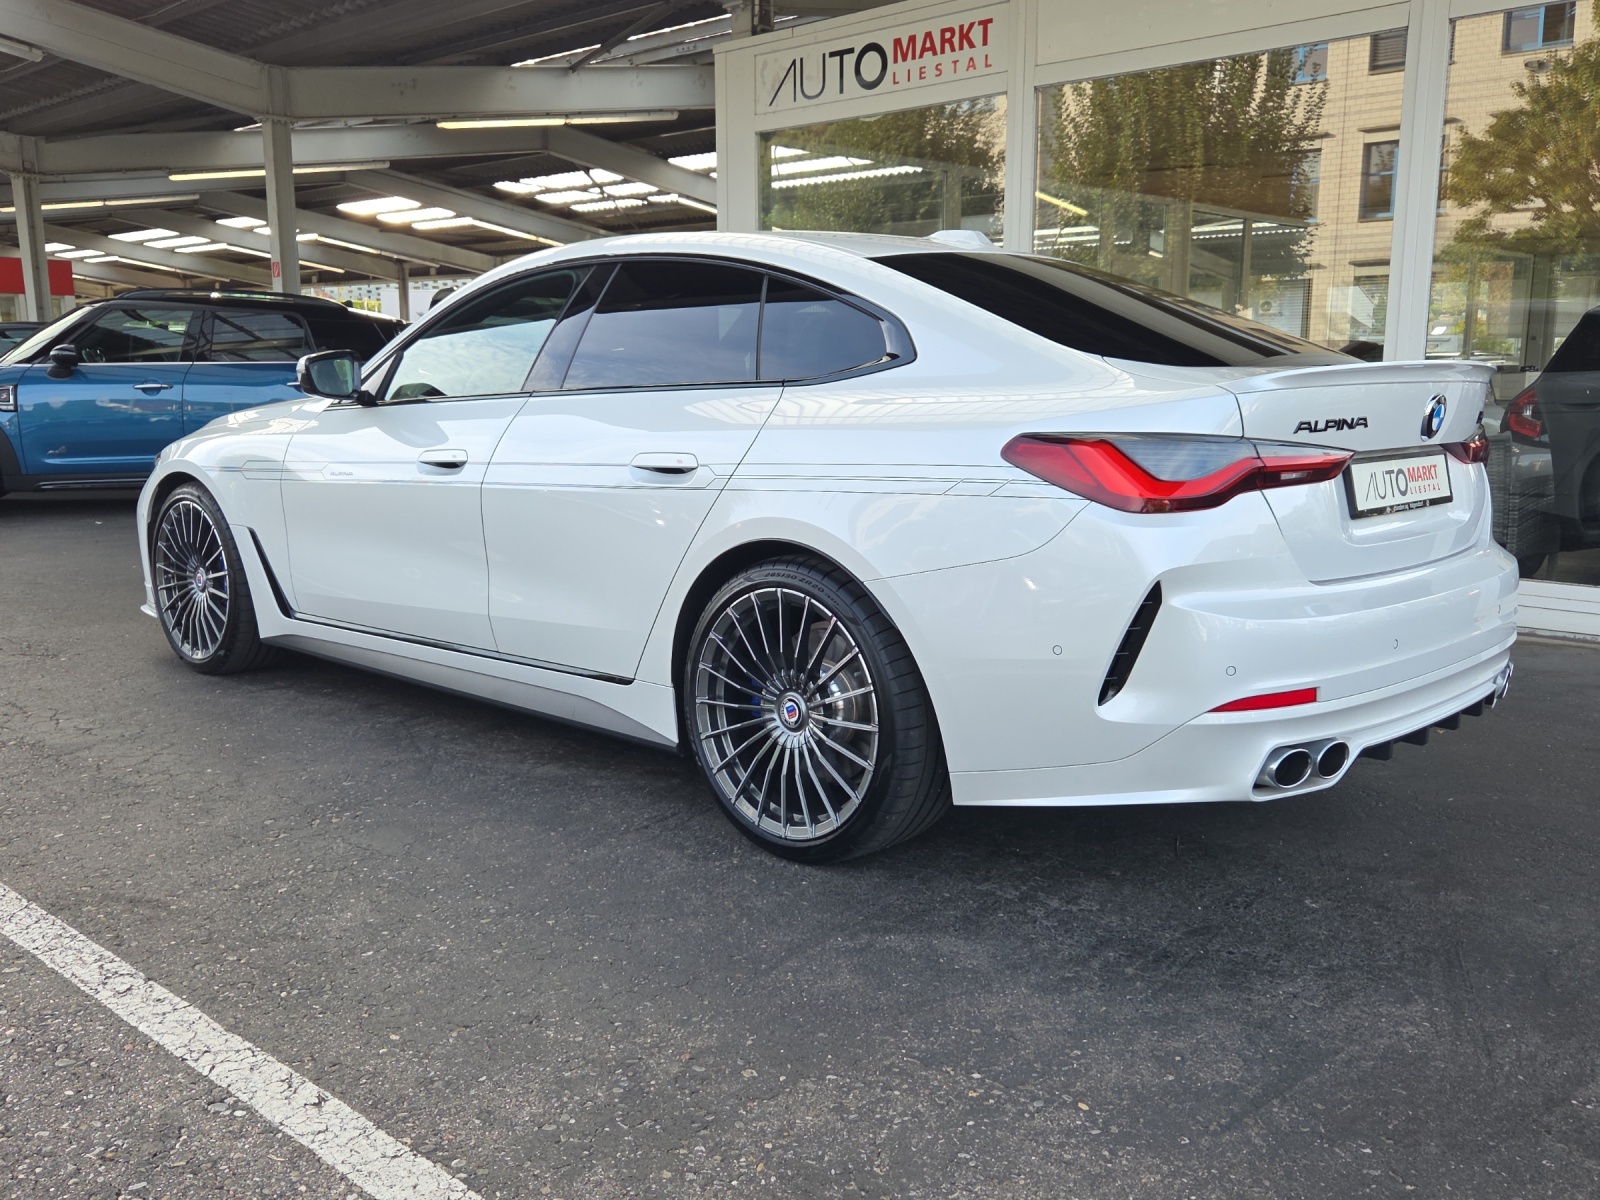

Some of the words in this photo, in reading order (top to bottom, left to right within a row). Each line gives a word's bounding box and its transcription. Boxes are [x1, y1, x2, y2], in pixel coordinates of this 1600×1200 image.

[769, 42, 888, 106] AUTO
[892, 18, 993, 64] MARKT
[892, 54, 992, 85] LIESTAL
[1293, 416, 1368, 434] ALPINA
[1366, 468, 1408, 502] AUTO
[1407, 464, 1438, 483] MARKT
[1409, 483, 1441, 494] LIESTAL
